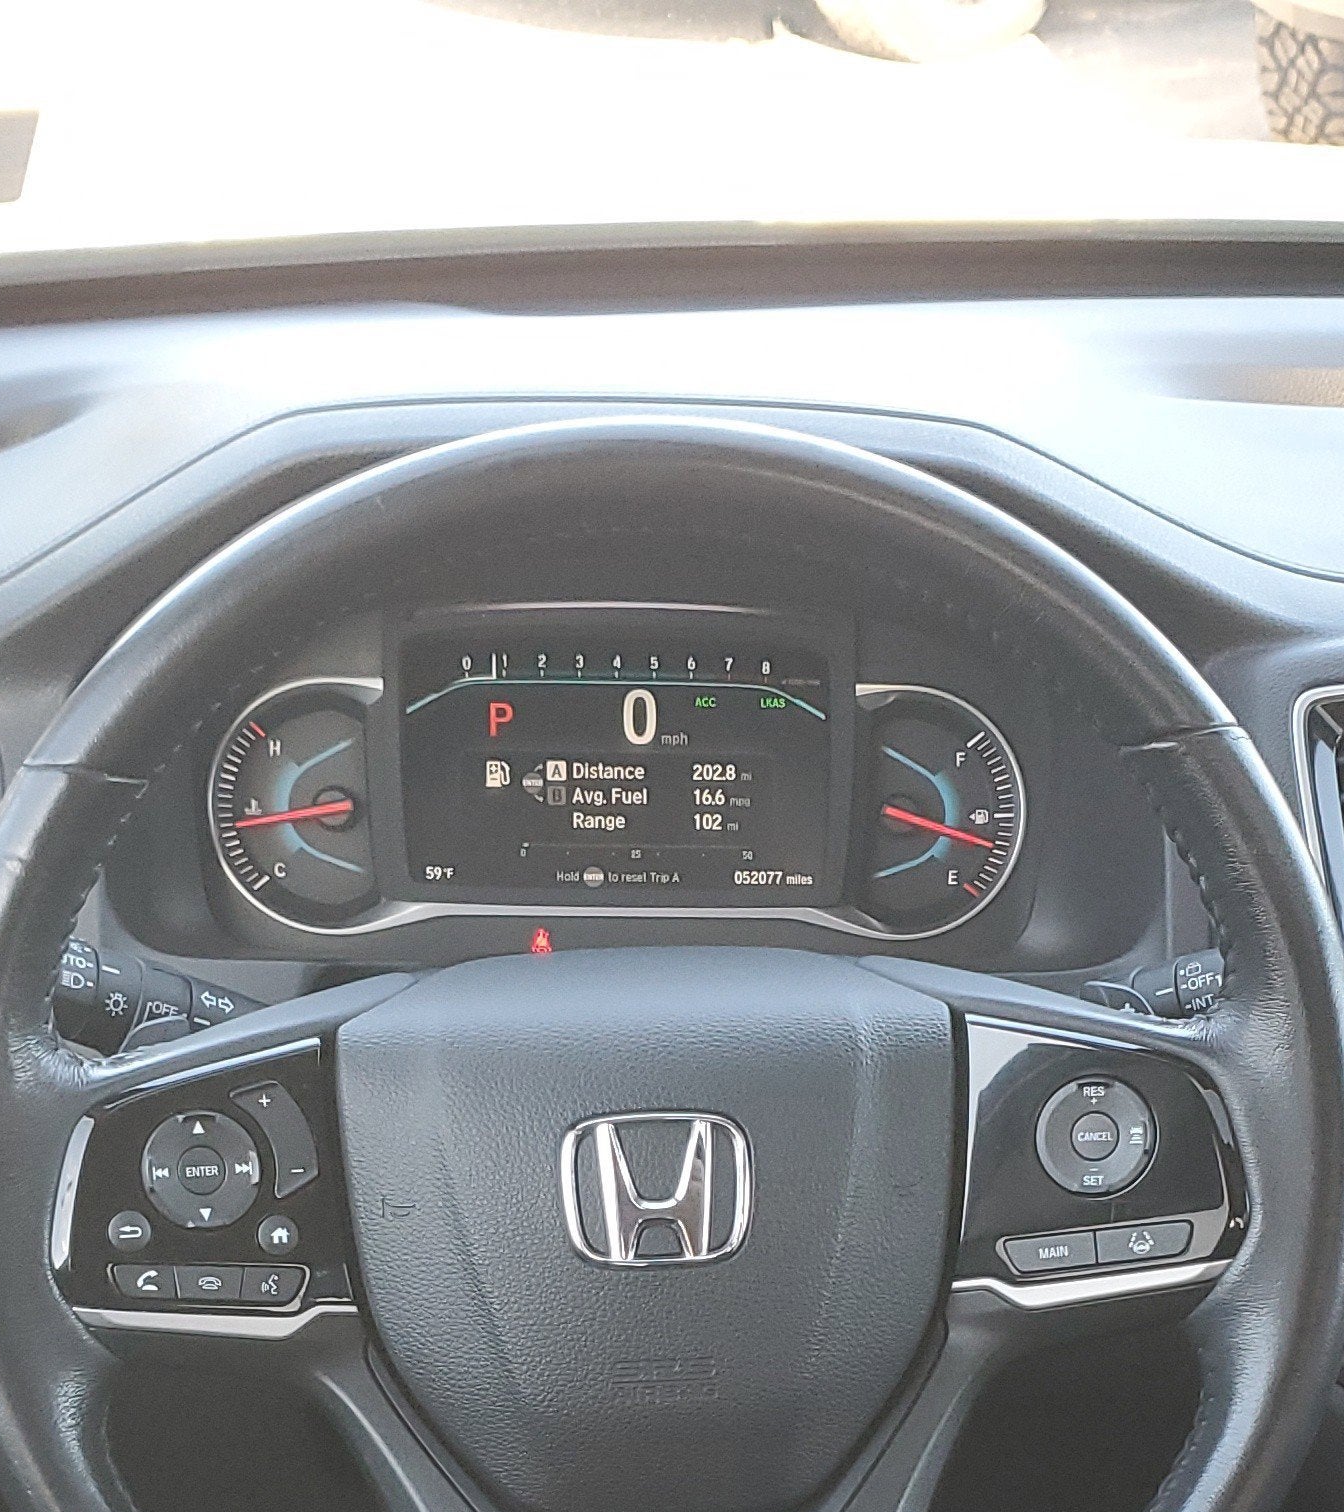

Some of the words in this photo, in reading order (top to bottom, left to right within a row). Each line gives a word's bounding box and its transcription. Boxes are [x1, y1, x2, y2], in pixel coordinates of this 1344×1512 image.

[695, 697, 717, 708] ACC
[760, 697, 786, 709] LKAS
[489, 702, 513, 736] P
[622, 688, 657, 745] 0
[661, 732, 689, 747] mph
[269, 740, 281, 757] H
[956, 751, 966, 768] F
[572, 762, 645, 780] Distance
[692, 764, 737, 781] 202.8
[572, 787, 607, 806] Avg.
[612, 787, 648, 805] Fuel
[694, 789, 726, 806] 16.6
[573, 812, 626, 831] Range
[694, 813, 723, 831] 102
[274, 862, 287, 878] C
[734, 870, 783, 886] 052077
[786, 872, 813, 885] miles
[948, 870, 959, 885] E
[556, 872, 579, 882] Hold
[650, 872, 670, 885] Trip
[1187, 972, 1214, 990] OFF
[152, 1002, 179, 1016] OFF
[1191, 994, 1214, 1011] INT
[1082, 1086, 1105, 1098] RES
[1077, 1130, 1113, 1142] CANCEL
[185, 1164, 219, 1179] ENTER
[1082, 1174, 1104, 1187] SET
[1038, 1245, 1069, 1260] MAIN
